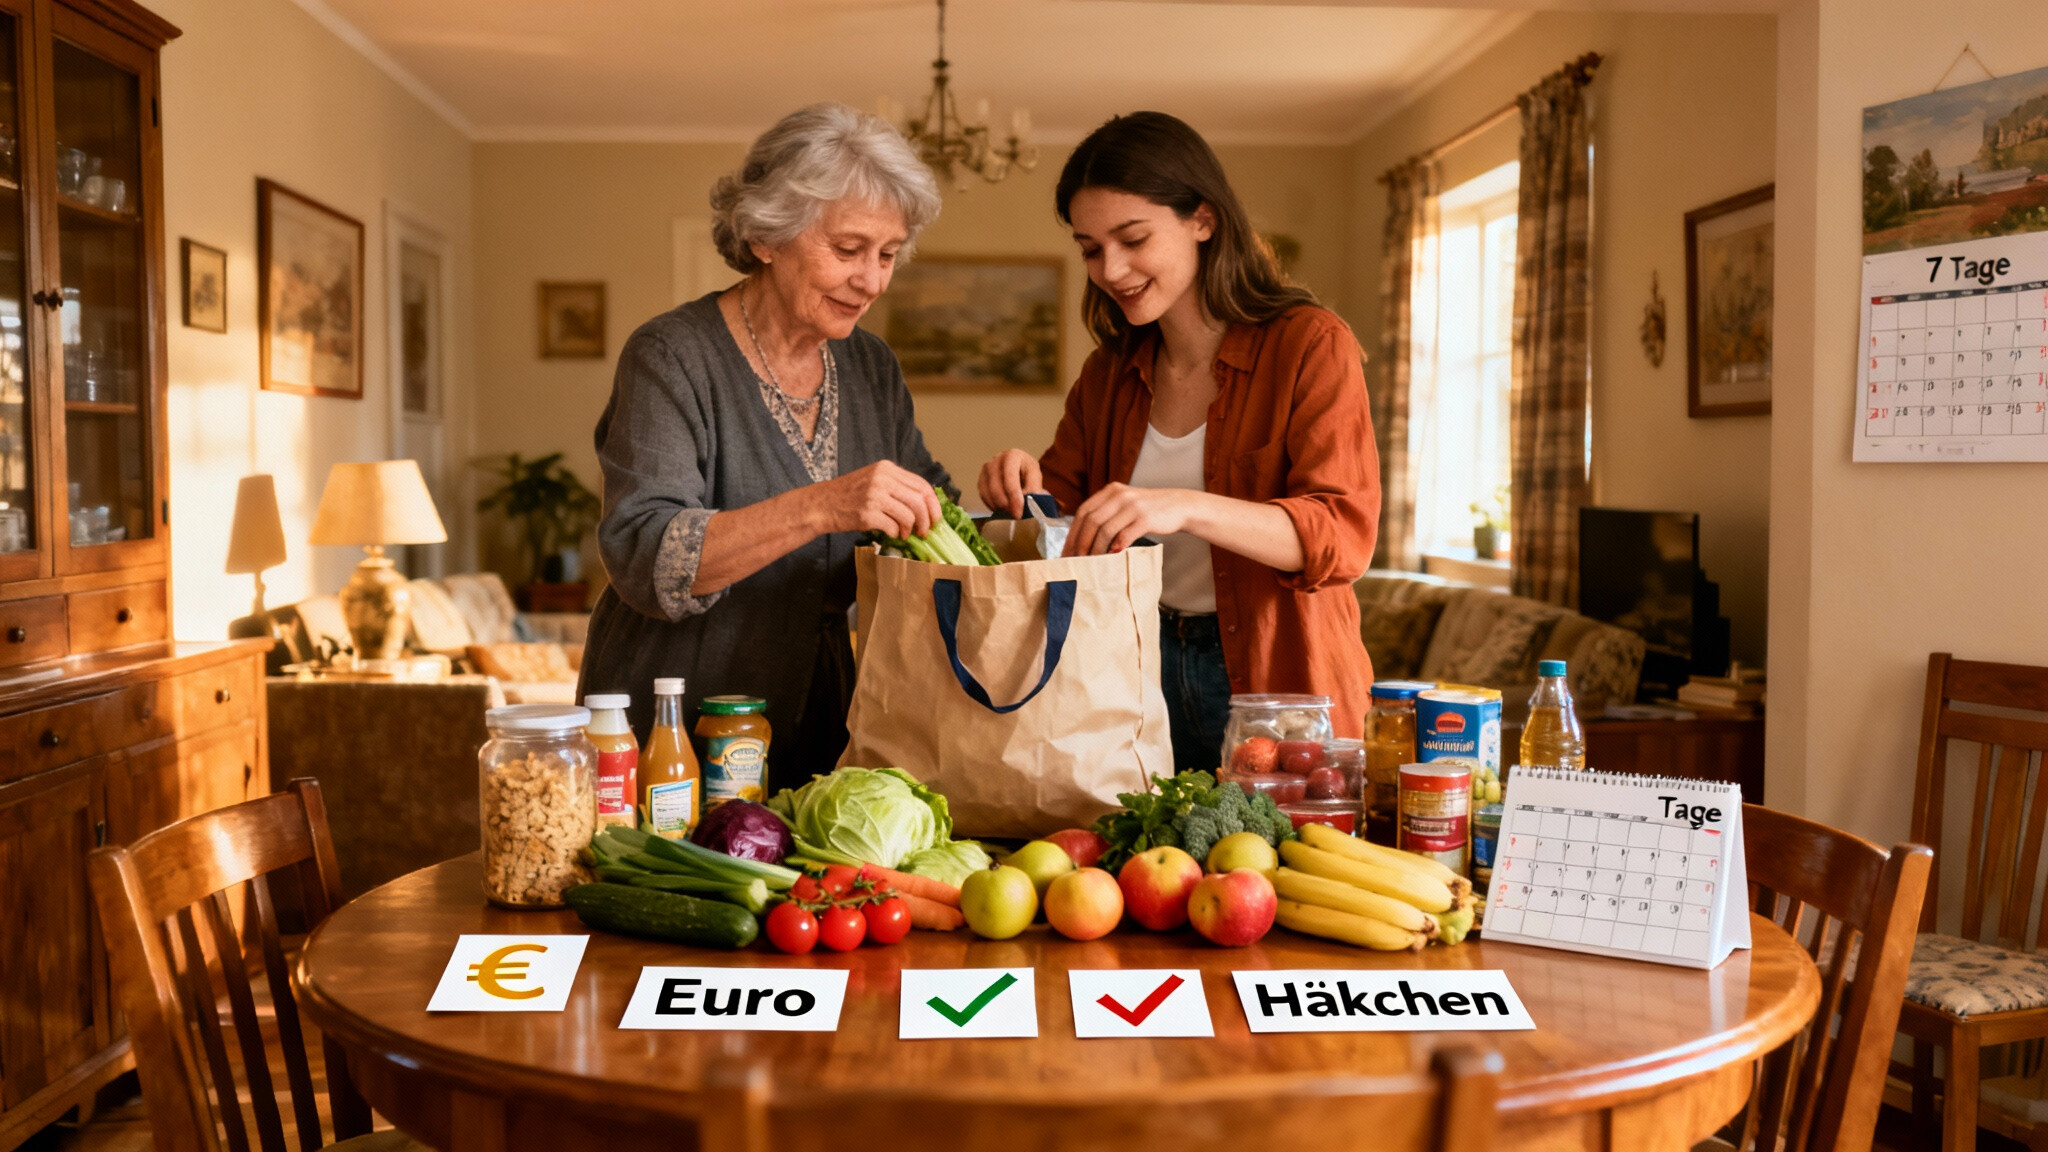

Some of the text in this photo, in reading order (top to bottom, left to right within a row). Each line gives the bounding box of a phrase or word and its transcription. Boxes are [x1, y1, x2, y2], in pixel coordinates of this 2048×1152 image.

[1926, 256, 2011, 286] 7 Tage
[1657, 796, 1723, 830] Tage
[467, 944, 548, 1000] €
[654, 978, 816, 1017] Euro
[1255, 980, 1510, 1018] Häkchen
